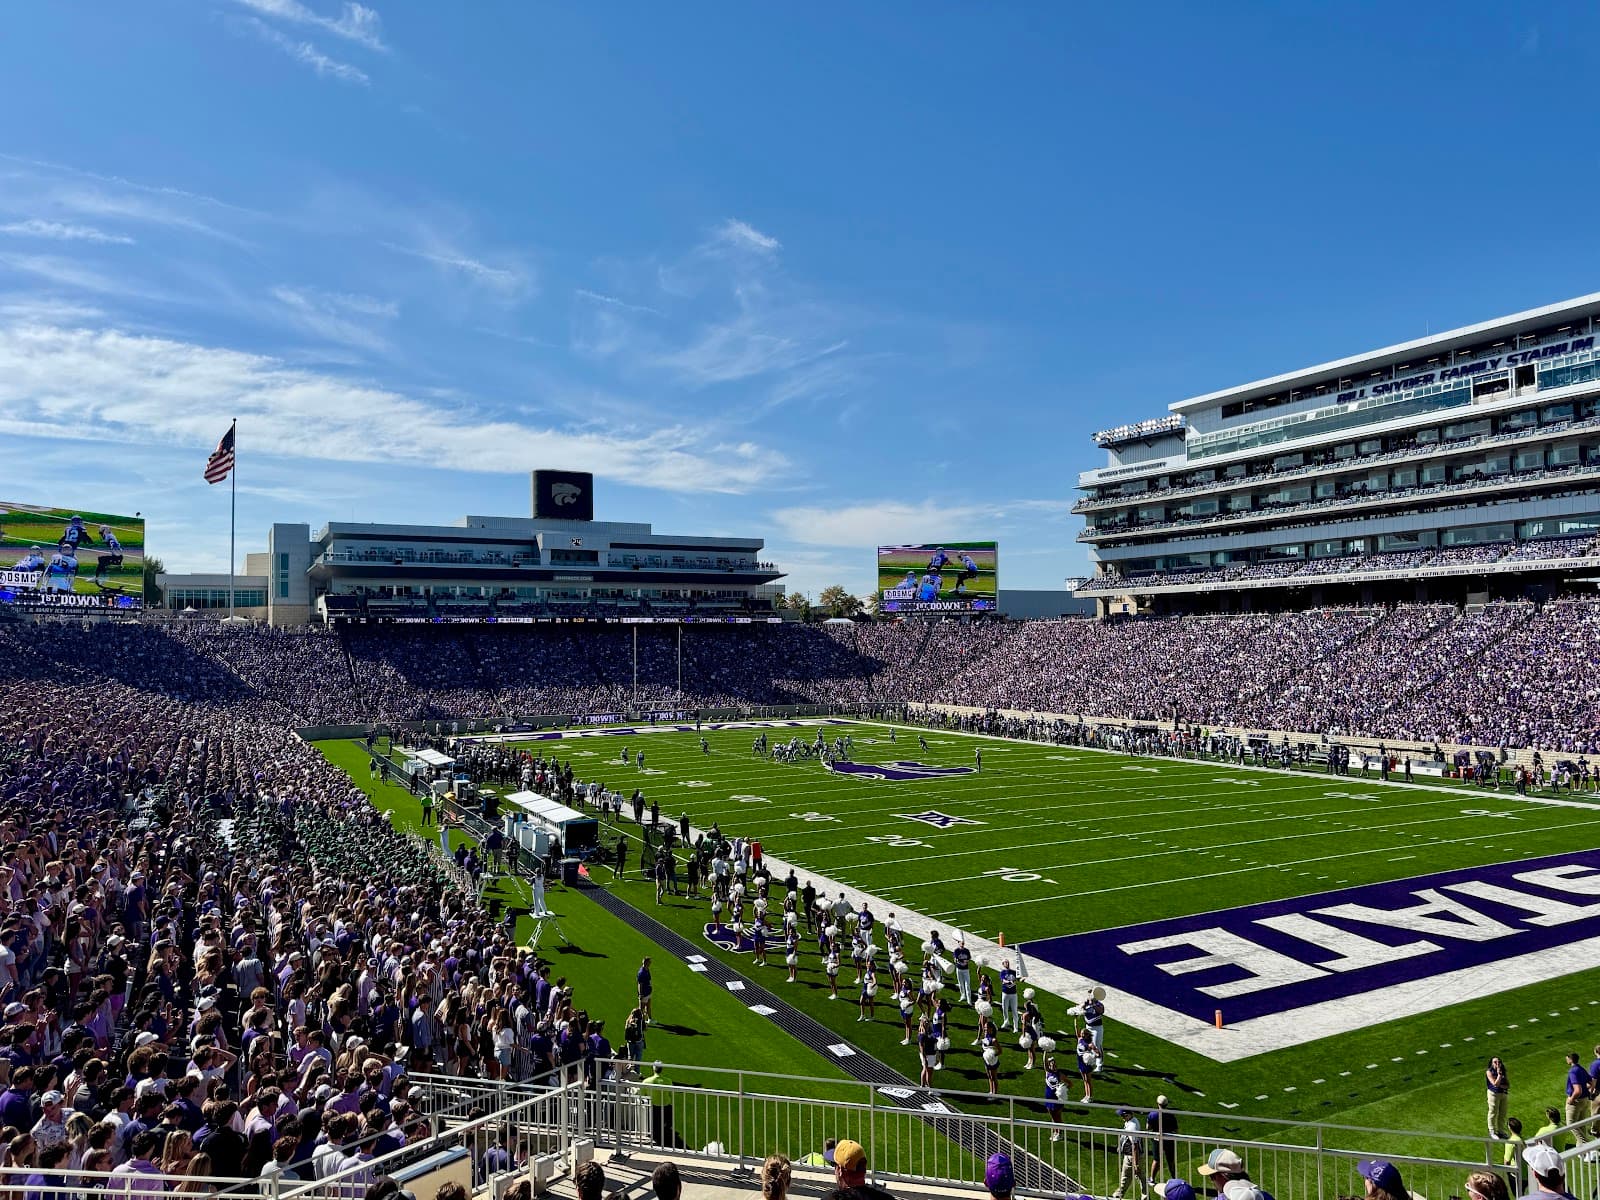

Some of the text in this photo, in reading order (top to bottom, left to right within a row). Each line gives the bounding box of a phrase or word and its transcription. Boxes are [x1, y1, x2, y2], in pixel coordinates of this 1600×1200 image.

[1372, 373, 1435, 395] SNYDER
[1440, 357, 1503, 381] FAMILY
[1506, 337, 1594, 367] STADIUM
[40, 595, 100, 606] 1ST DOWN
[930, 602, 960, 610] DOWN
[589, 714, 616, 723] DOWN
[863, 834, 923, 847] 20
[982, 866, 1042, 882] 10
